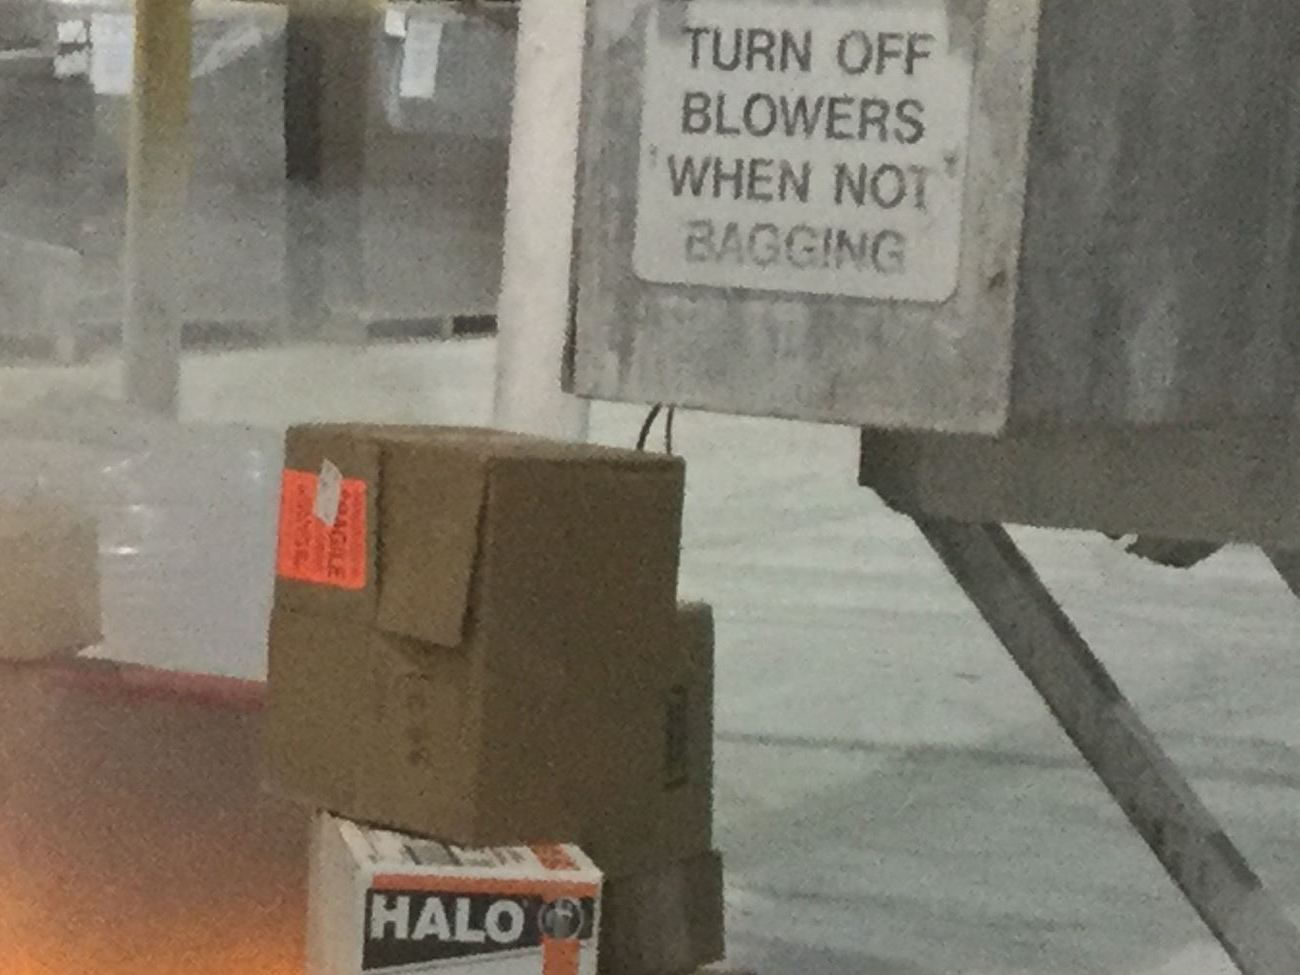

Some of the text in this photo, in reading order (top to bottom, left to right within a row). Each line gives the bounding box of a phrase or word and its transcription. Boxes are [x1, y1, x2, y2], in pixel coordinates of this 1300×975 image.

[683, 27, 936, 75] TURN OFF
[680, 91, 927, 144] BLOWERS
[667, 154, 936, 210] WHEN NOT
[683, 219, 907, 275] BAGGING
[369, 894, 526, 944] HALO
